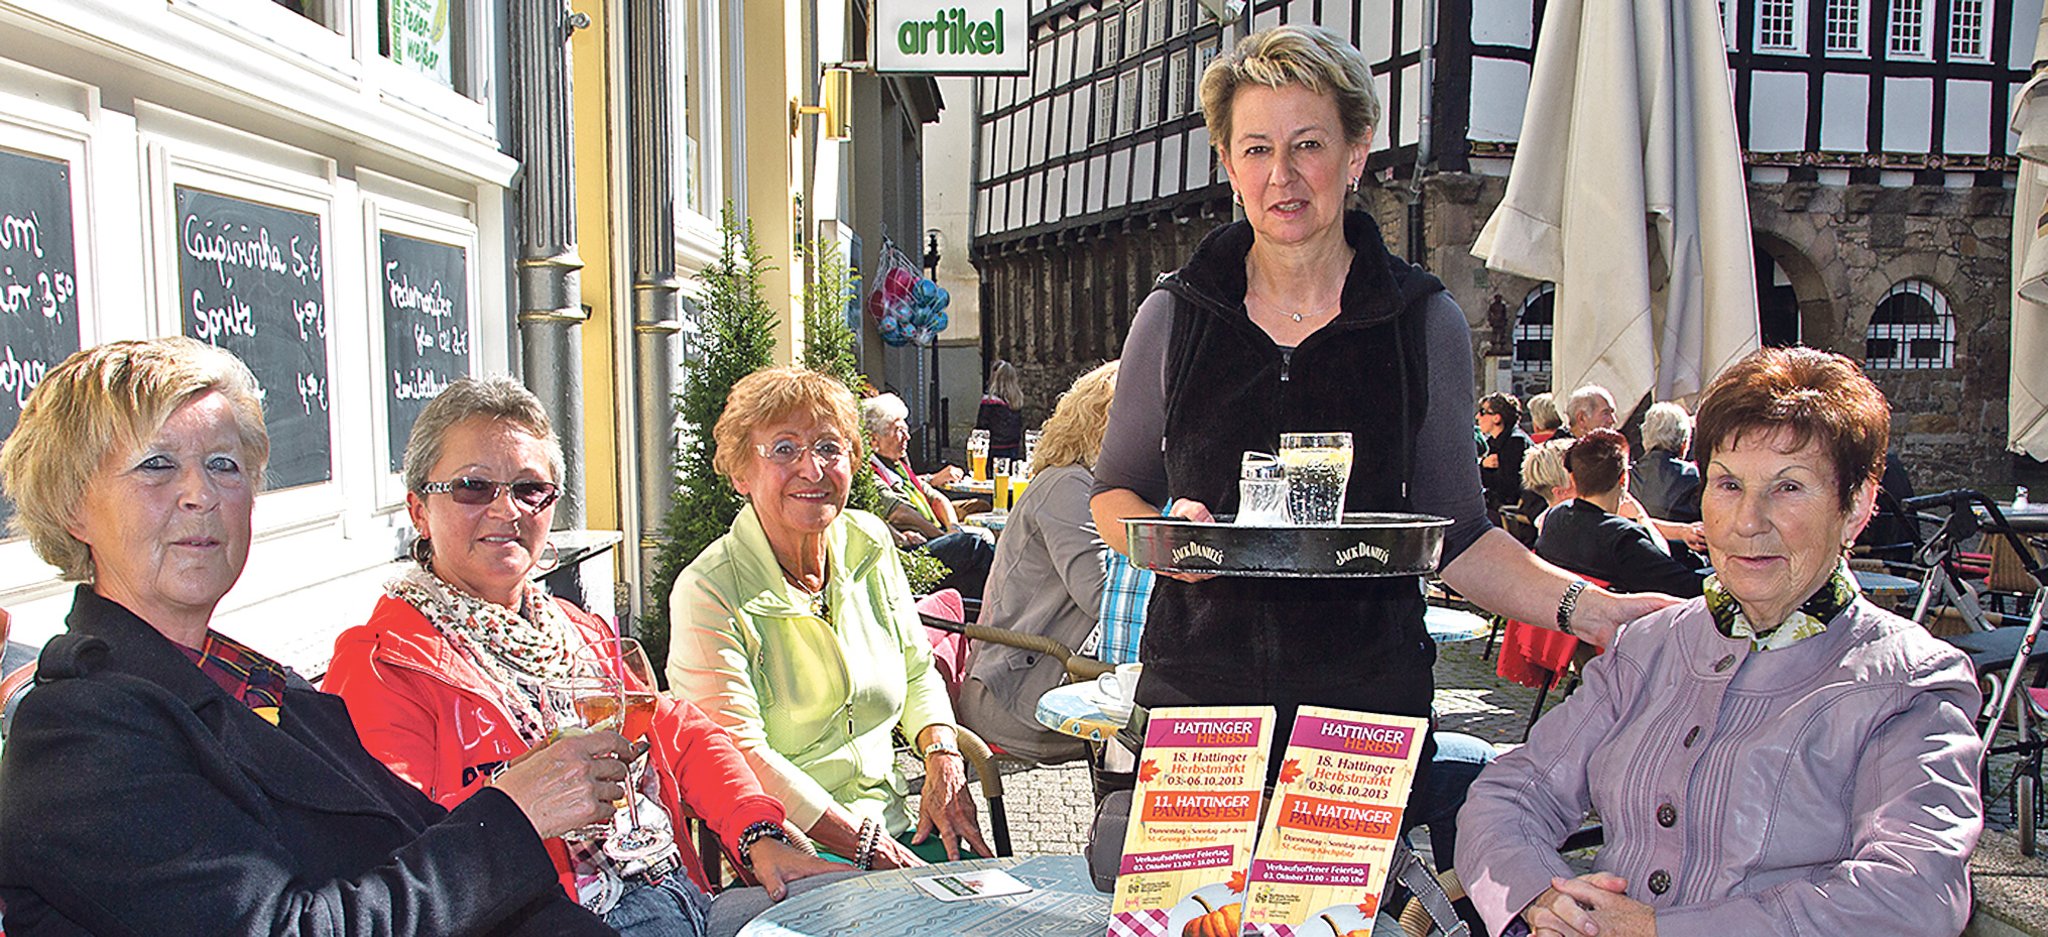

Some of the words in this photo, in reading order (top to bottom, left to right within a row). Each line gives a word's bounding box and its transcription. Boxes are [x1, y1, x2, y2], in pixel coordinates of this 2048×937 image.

[897, 7, 1004, 56] artikel
[184, 214, 288, 289] Caipirinha
[192, 289, 257, 350] Spritz
[1171, 544, 1191, 565] JACK
[1190, 541, 1224, 566] DANIEL'S
[1335, 545, 1359, 567] JACK
[1359, 541, 1390, 566] DANIEL'S
[1173, 721, 1253, 735] HATTINGER
[1196, 732, 1250, 745] HERBST
[1321, 721, 1405, 745] HATTINGER
[1343, 736, 1402, 754] HERBST
[1172, 752, 1188, 763] 18.
[1192, 752, 1248, 764] Hattinger
[1316, 755, 1333, 768] 18.
[1337, 757, 1395, 776] Hattinger
[1171, 763, 1246, 775] Herbstmarkt
[1314, 766, 1393, 787] Herbstmarkt
[1151, 806, 1249, 818] PANHAS-FEST
[1154, 796, 1173, 808] 11.
[1176, 795, 1251, 808] HATTINGER
[1292, 800, 1312, 815] 11.
[1315, 803, 1393, 824] HATTINGER
[1289, 810, 1388, 835] PANHAS-FEST
